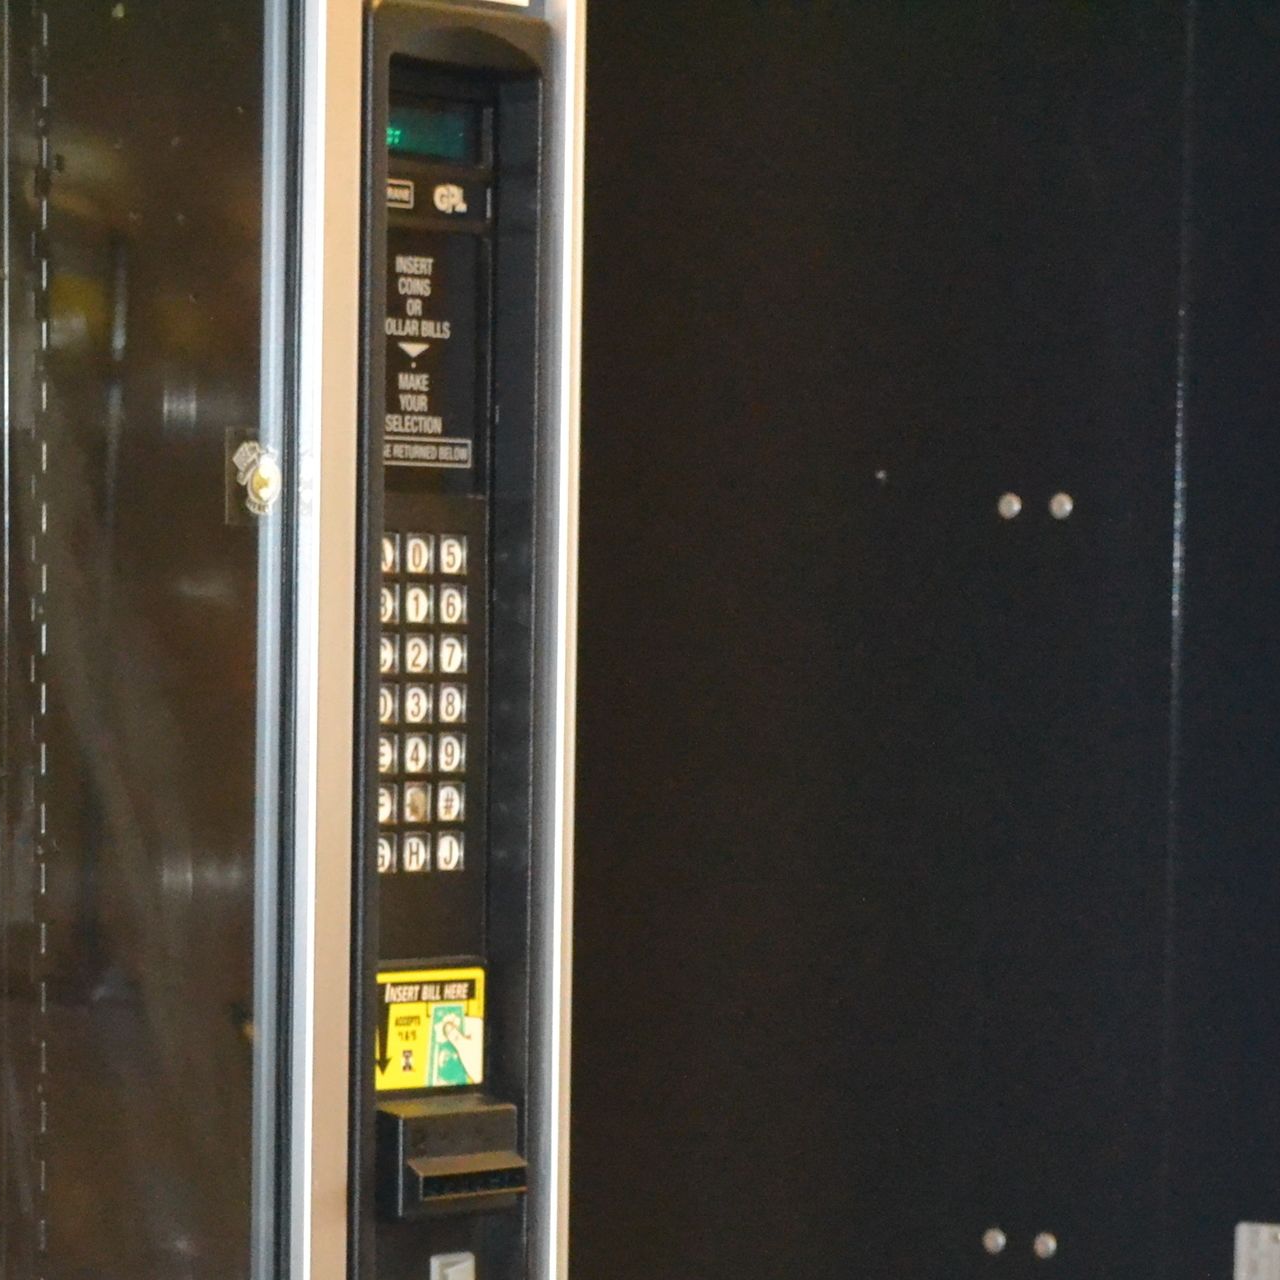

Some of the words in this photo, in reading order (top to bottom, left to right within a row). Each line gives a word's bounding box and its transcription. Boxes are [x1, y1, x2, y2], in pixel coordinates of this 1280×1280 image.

[395, 255, 434, 276] INSERT
[398, 277, 431, 297] COINS
[406, 298, 422, 317] OR
[385, 318, 419, 337] OLLAR
[420, 320, 451, 340] BILLS
[398, 372, 430, 392] MAKE
[399, 393, 428, 413] YOUR
[384, 414, 442, 435] SELECTION
[444, 543, 457, 567] 5
[445, 596, 457, 620] 6
[411, 643, 423, 668] 2
[445, 643, 456, 668] 7
[410, 692, 422, 717] 3
[444, 692, 456, 717] 8
[409, 741, 422, 765] 4
[444, 741, 455, 767] 9
[408, 836, 420, 861] H
[385, 983, 421, 1003] INSERT
[422, 982, 442, 1001] BILL
[443, 981, 470, 1000] HERE
